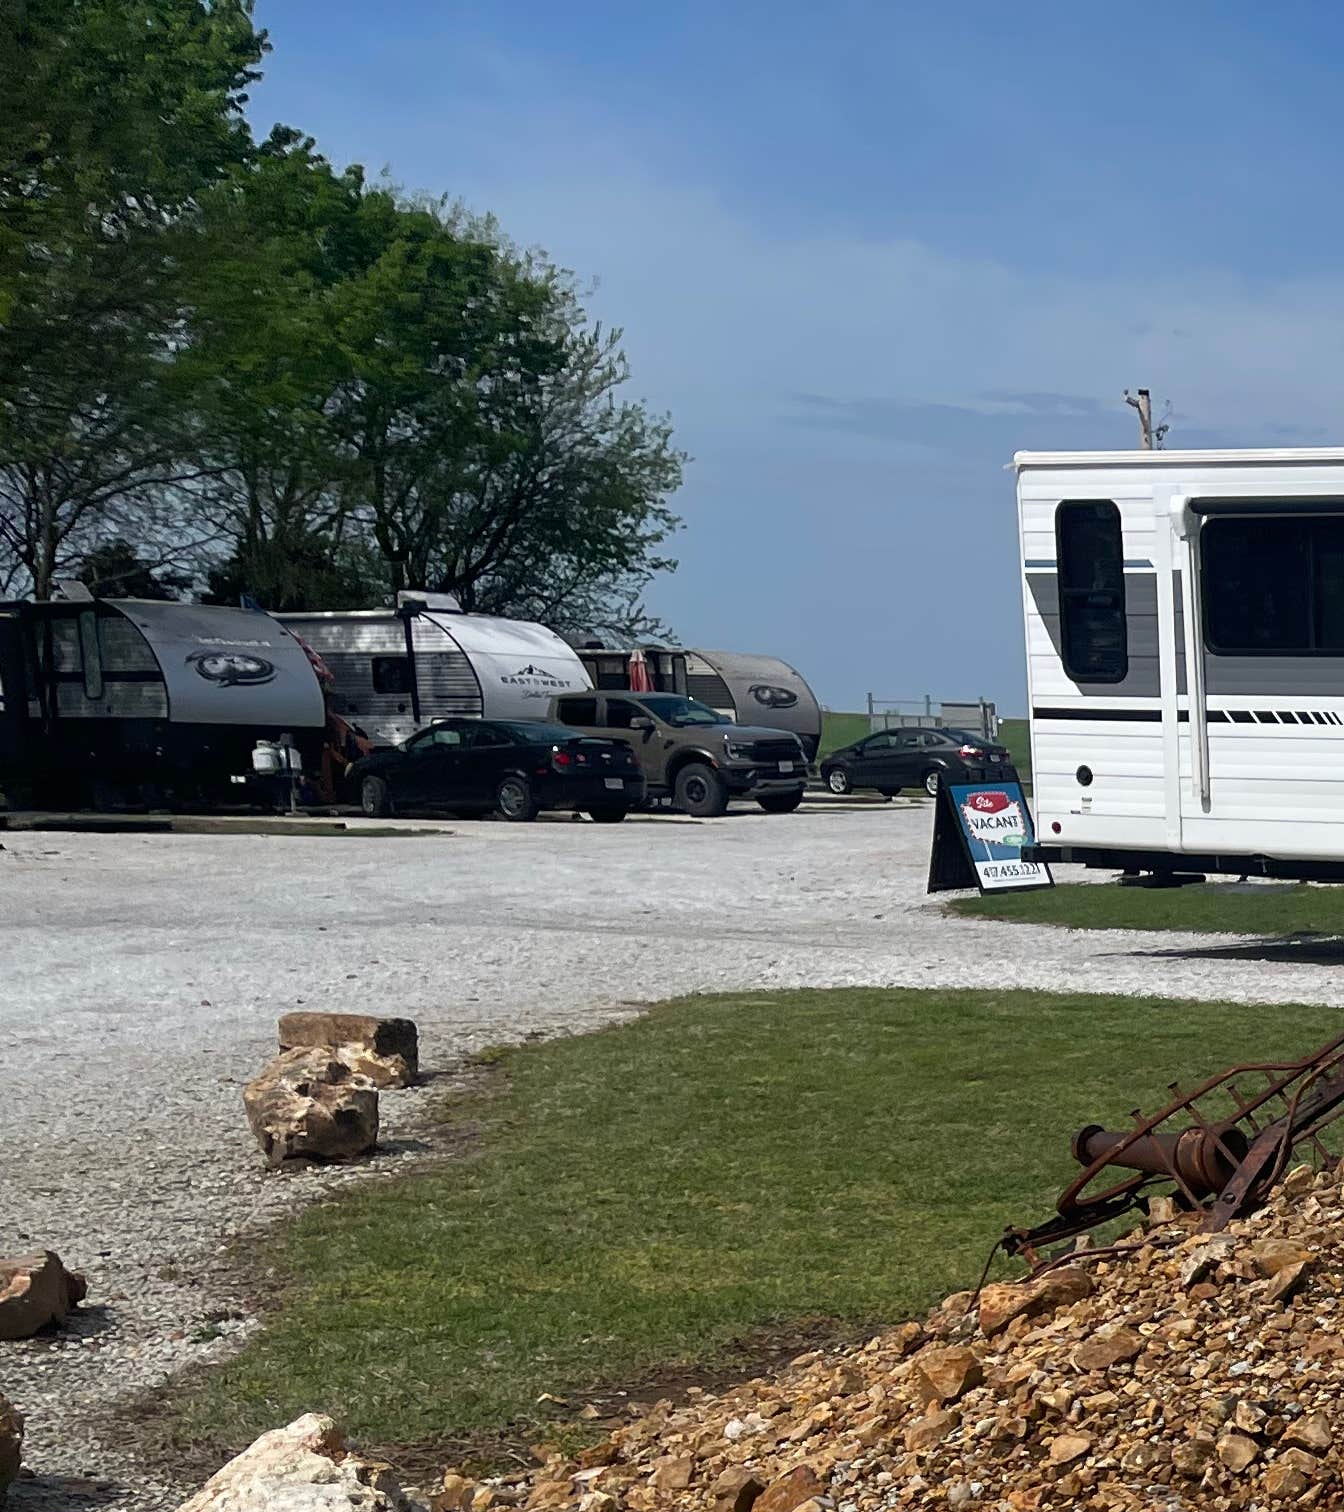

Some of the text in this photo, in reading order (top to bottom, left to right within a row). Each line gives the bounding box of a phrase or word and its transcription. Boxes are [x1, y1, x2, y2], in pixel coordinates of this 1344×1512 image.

[500, 676, 531, 685] EAST
[541, 680, 570, 688] WEST
[970, 815, 1018, 830] VACANT
